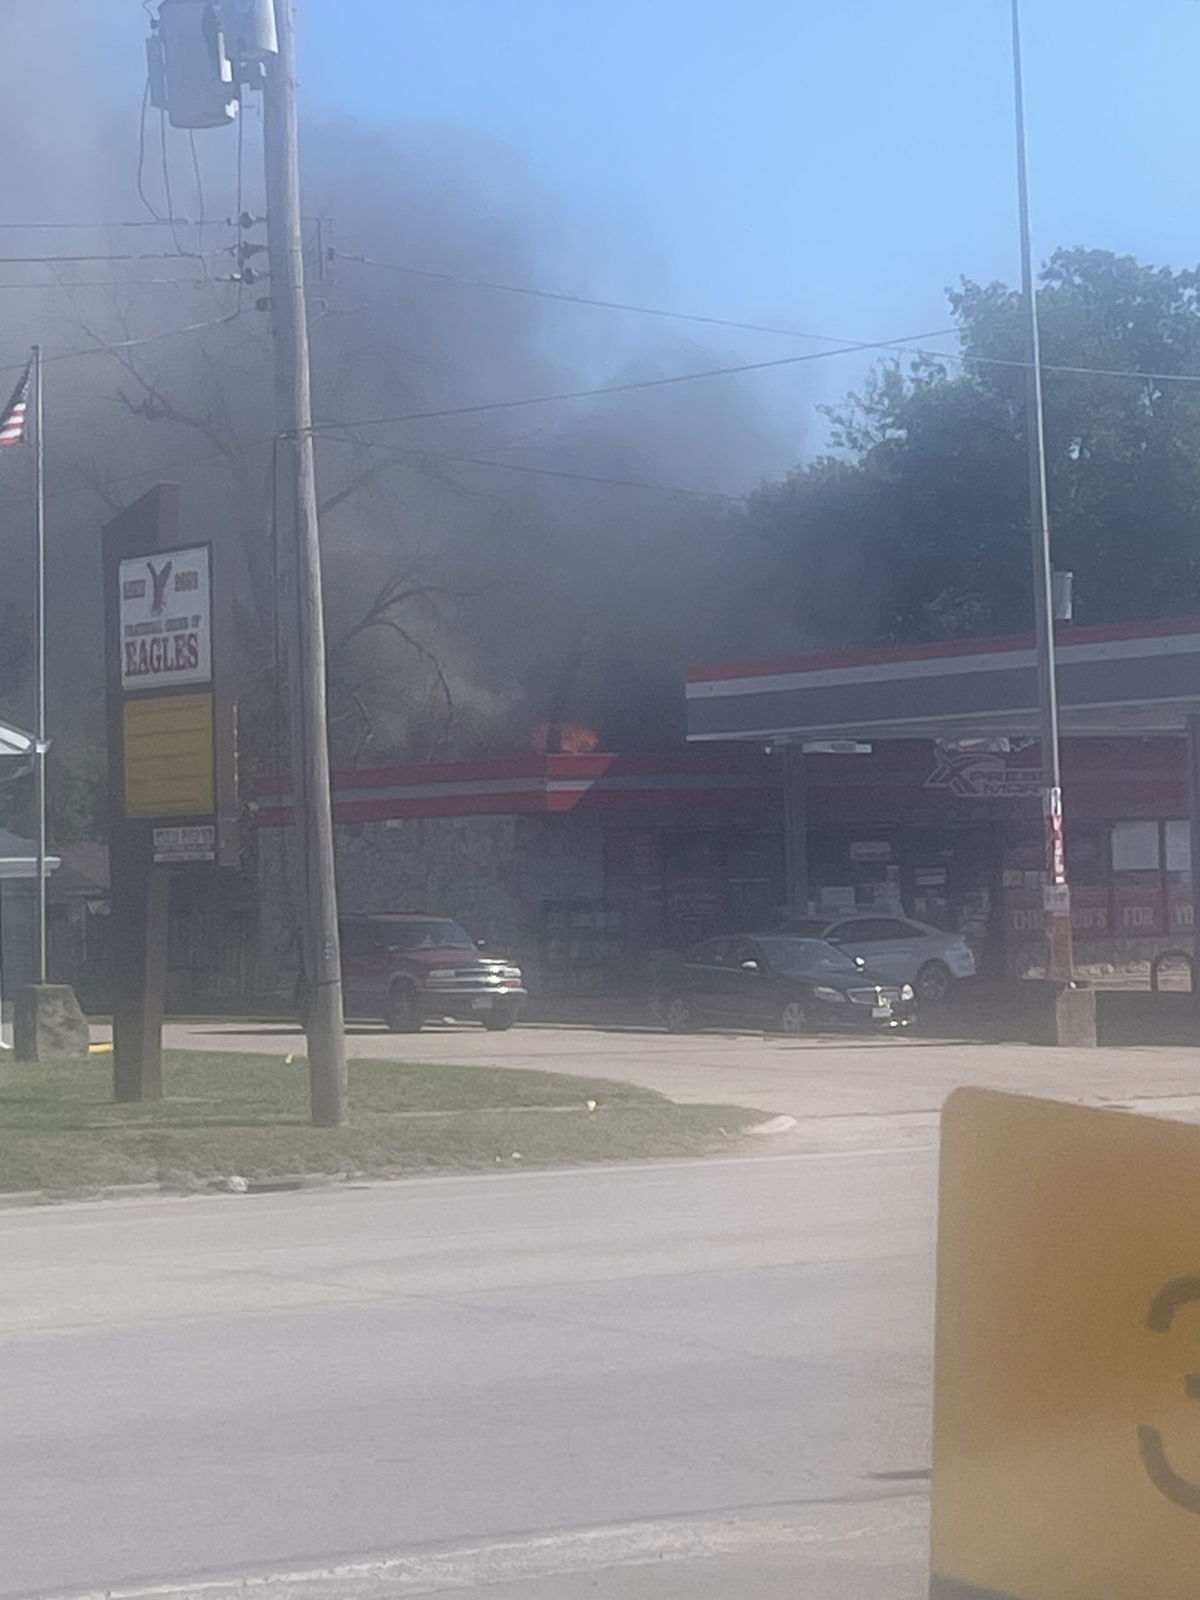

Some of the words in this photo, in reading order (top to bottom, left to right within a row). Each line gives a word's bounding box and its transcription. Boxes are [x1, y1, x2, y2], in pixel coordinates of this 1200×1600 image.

[125, 633, 199, 676] EAGLES
[921, 745, 1044, 798] XPRES
[981, 783, 1044, 797] MAR
[1071, 907, 1108, 929] UD'S
[1123, 905, 1154, 928] FOR
[1174, 903, 1195, 926] YO
